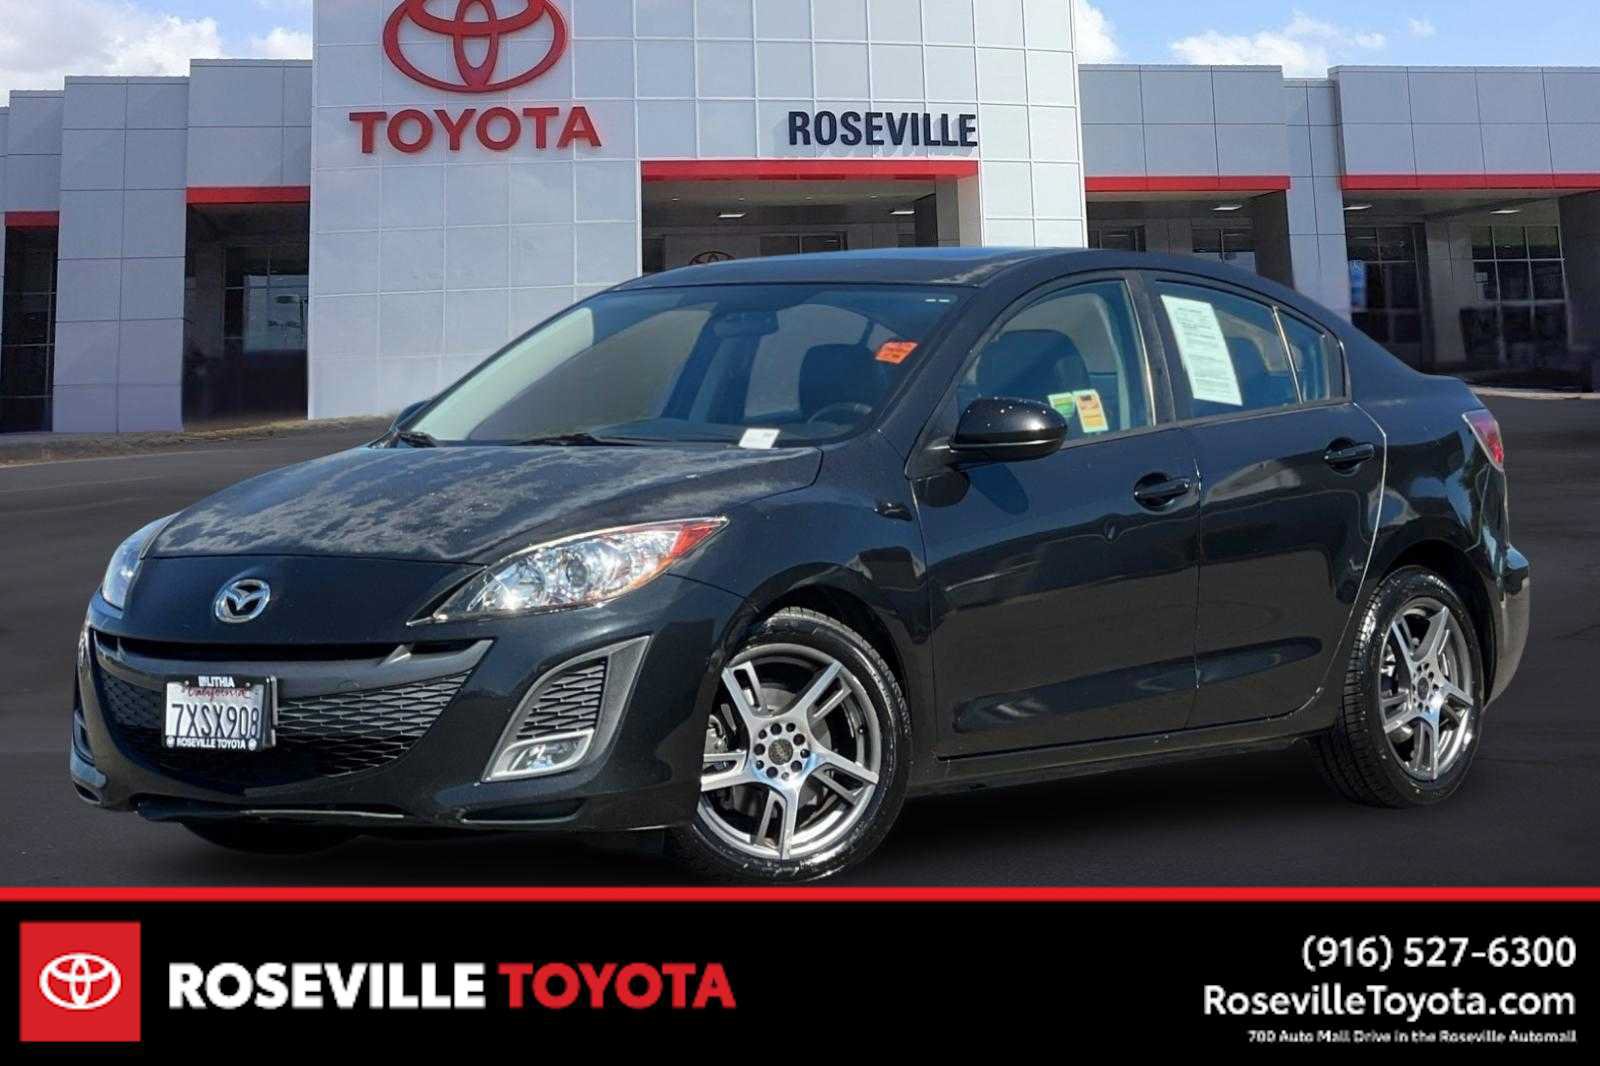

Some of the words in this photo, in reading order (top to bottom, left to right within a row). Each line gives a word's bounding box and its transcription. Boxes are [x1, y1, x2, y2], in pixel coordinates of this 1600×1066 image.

[349, 106, 602, 154] TOYOTA
[788, 111, 978, 147] ROSEVILLE
[171, 703, 260, 739] 7XSX908
[176, 737, 216, 749] ROSEVILLE
[217, 738, 247, 750] TOYOTA
